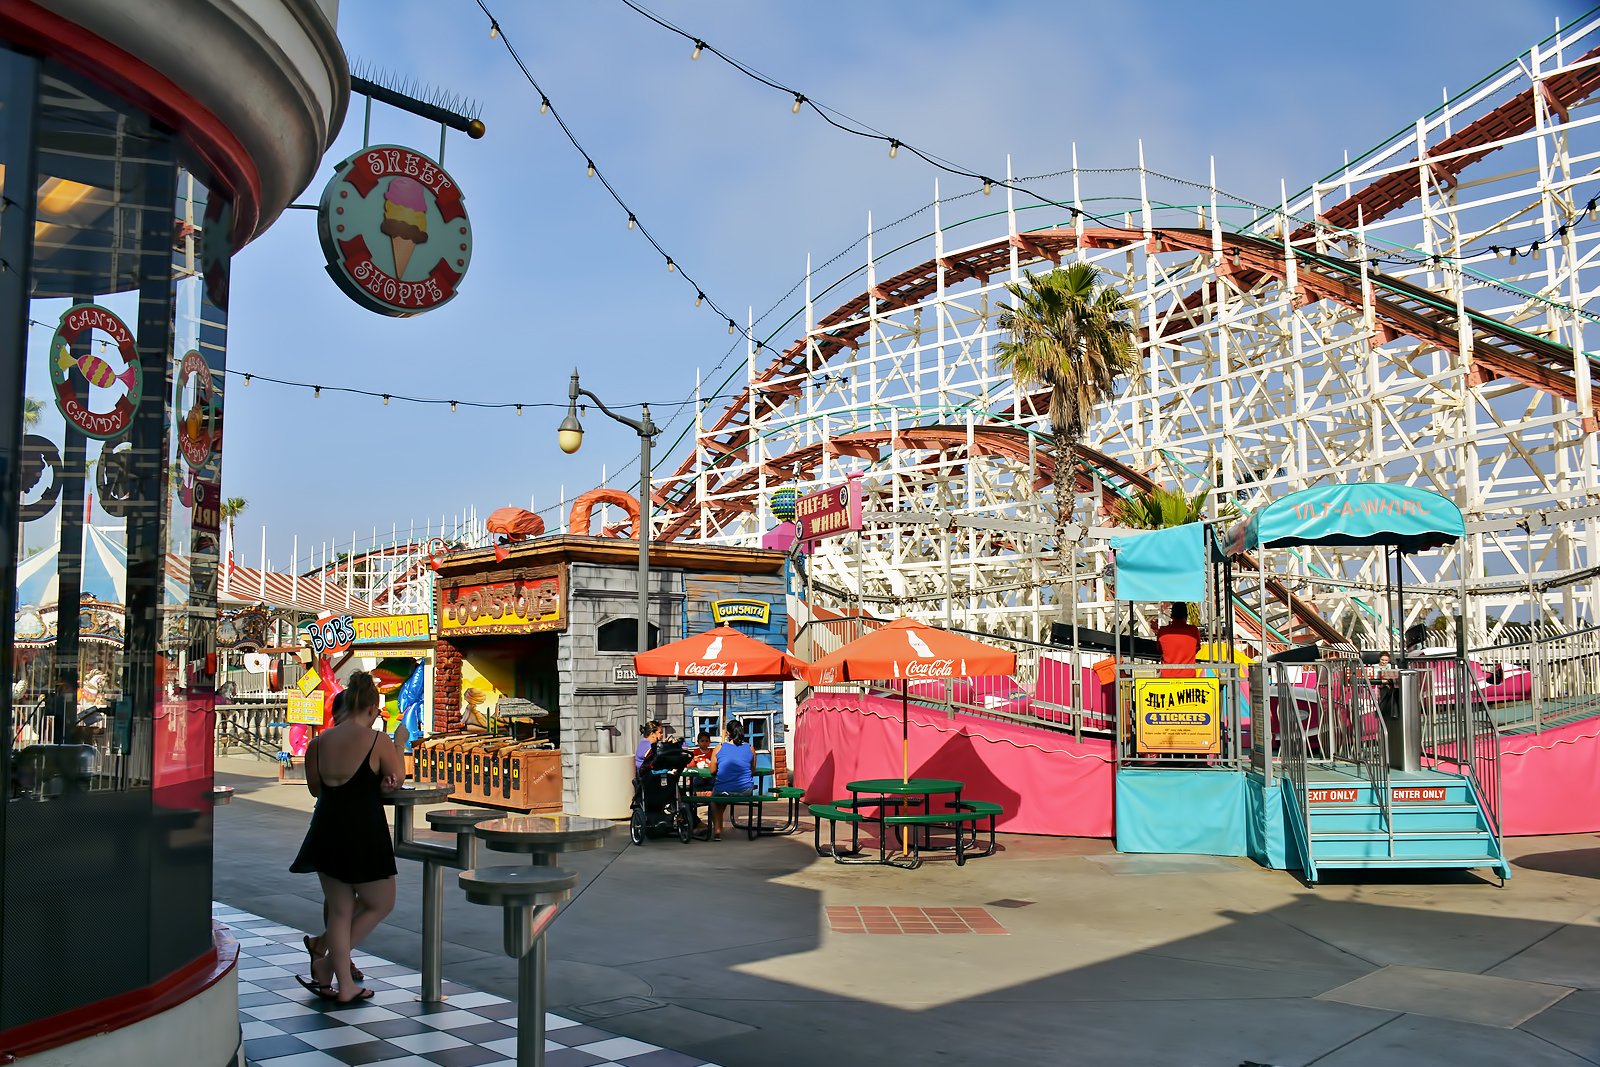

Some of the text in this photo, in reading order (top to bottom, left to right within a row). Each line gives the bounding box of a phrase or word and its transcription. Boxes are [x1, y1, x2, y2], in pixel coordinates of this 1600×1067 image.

[367, 150, 452, 195] SWEET
[354, 260, 443, 305] SHOPPE
[69, 310, 131, 343] CANDY
[66, 400, 123, 432] CANDY
[181, 435, 208, 463] APPLE
[1289, 497, 1431, 520] TILT-A-WHIRL
[811, 509, 847, 534] WHIRL
[719, 604, 765, 617] GUNSMITH
[306, 615, 356, 654] BOB'S
[357, 621, 393, 639] FISHIN'
[397, 618, 424, 637] HOLE
[616, 669, 639, 680] BAN
[684, 661, 729, 676] Coca-Cola
[905, 659, 955, 677] Coca-Cola
[1145, 691, 1166, 709] TILT
[1168, 692, 1175, 708] A
[1149, 713, 1206, 722] 4 TICKETS
[1308, 790, 1355, 801] EXIT ONLY
[1393, 789, 1445, 799] ENTER ONLY
